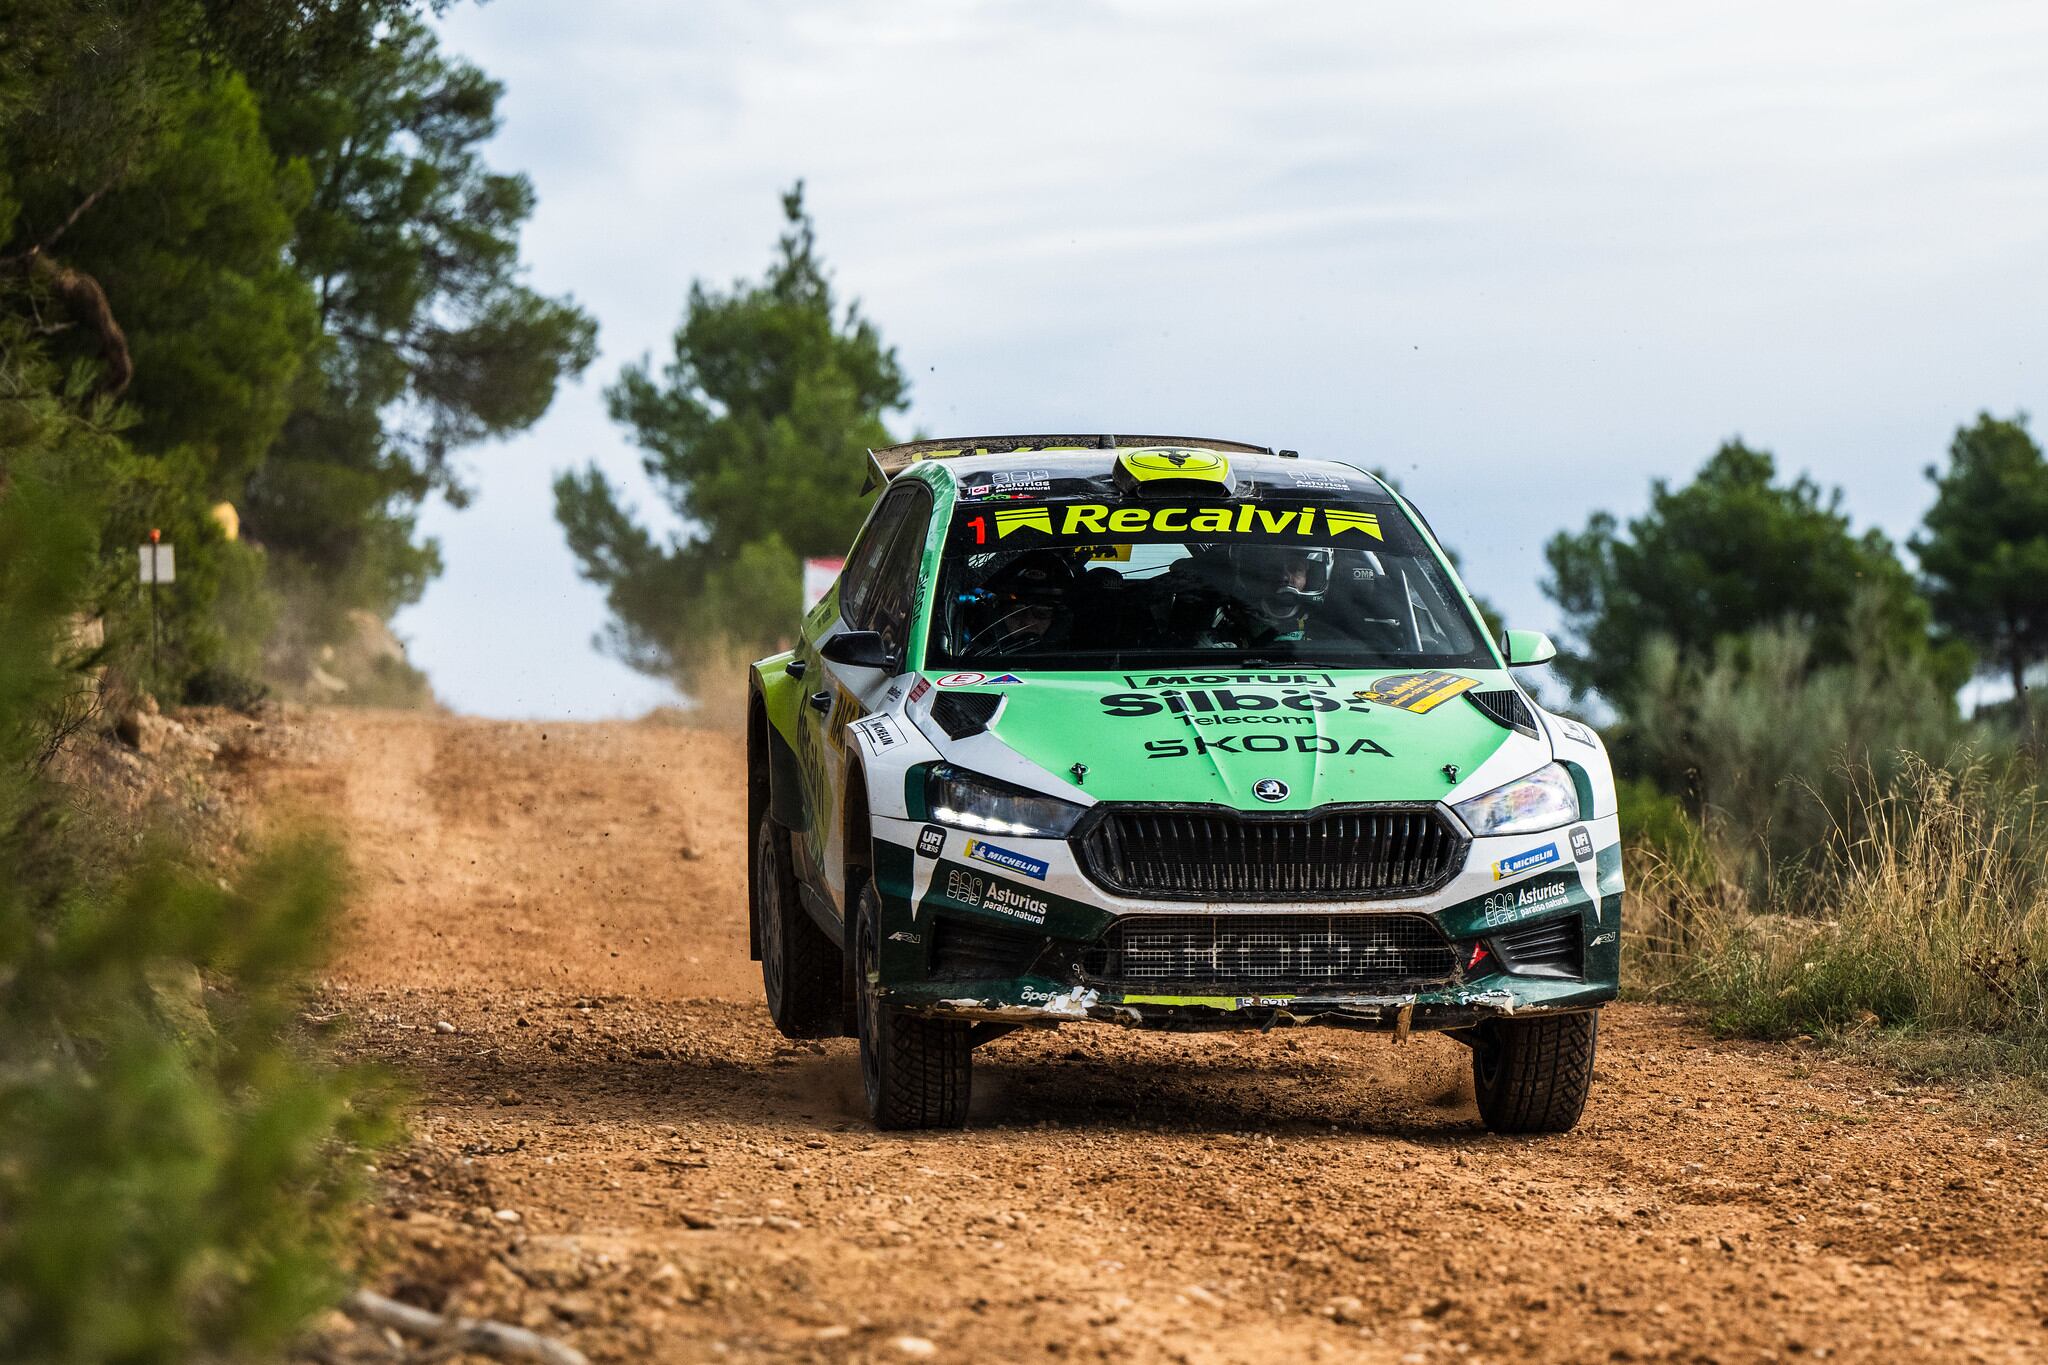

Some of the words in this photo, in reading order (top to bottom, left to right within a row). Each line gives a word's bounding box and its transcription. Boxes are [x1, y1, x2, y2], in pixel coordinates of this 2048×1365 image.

[995, 480, 1050, 489] Asturias
[967, 517, 986, 544] 1
[1061, 504, 1316, 536] Recalvi
[952, 674, 973, 682] E
[1145, 675, 1318, 686] MOTUL
[1174, 714, 1314, 726] Telecom
[870, 721, 895, 746] MICHELIN
[1144, 735, 1395, 758] SKODA
[922, 830, 943, 846] UFI
[1571, 832, 1589, 848] UFI
[987, 851, 1040, 875] MICHELIN
[1512, 849, 1553, 871] MICHELIN
[986, 881, 1048, 915] Asturias
[1517, 881, 1566, 907] Asturias
[1545, 895, 1570, 911] natural
[1013, 908, 1045, 925] natural
[1127, 933, 1408, 977] SKODA
